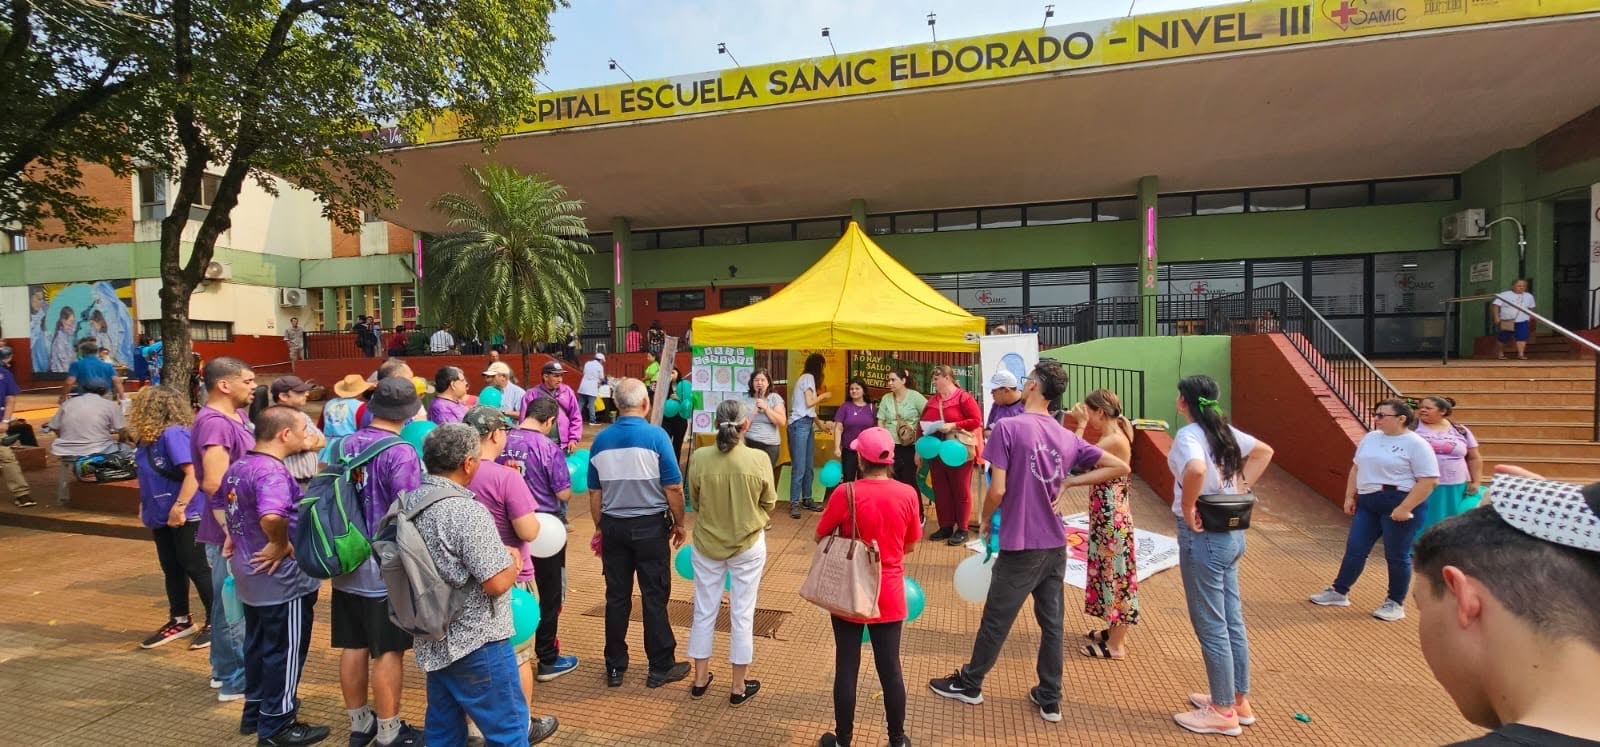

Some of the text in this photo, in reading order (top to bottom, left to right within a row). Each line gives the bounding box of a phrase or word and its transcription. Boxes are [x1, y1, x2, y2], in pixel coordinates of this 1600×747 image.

[522, 93, 610, 125] SPITAL
[621, 74, 758, 113] ESCUELA
[769, 58, 876, 95] SAMIC
[890, 31, 1094, 81] ELDORADO
[1138, 12, 1262, 52] NIVEL
[1280, 4, 1311, 36] III
[866, 355, 881, 364] HAY
[865, 362, 891, 372] SALUD
[853, 369, 865, 378] SN
